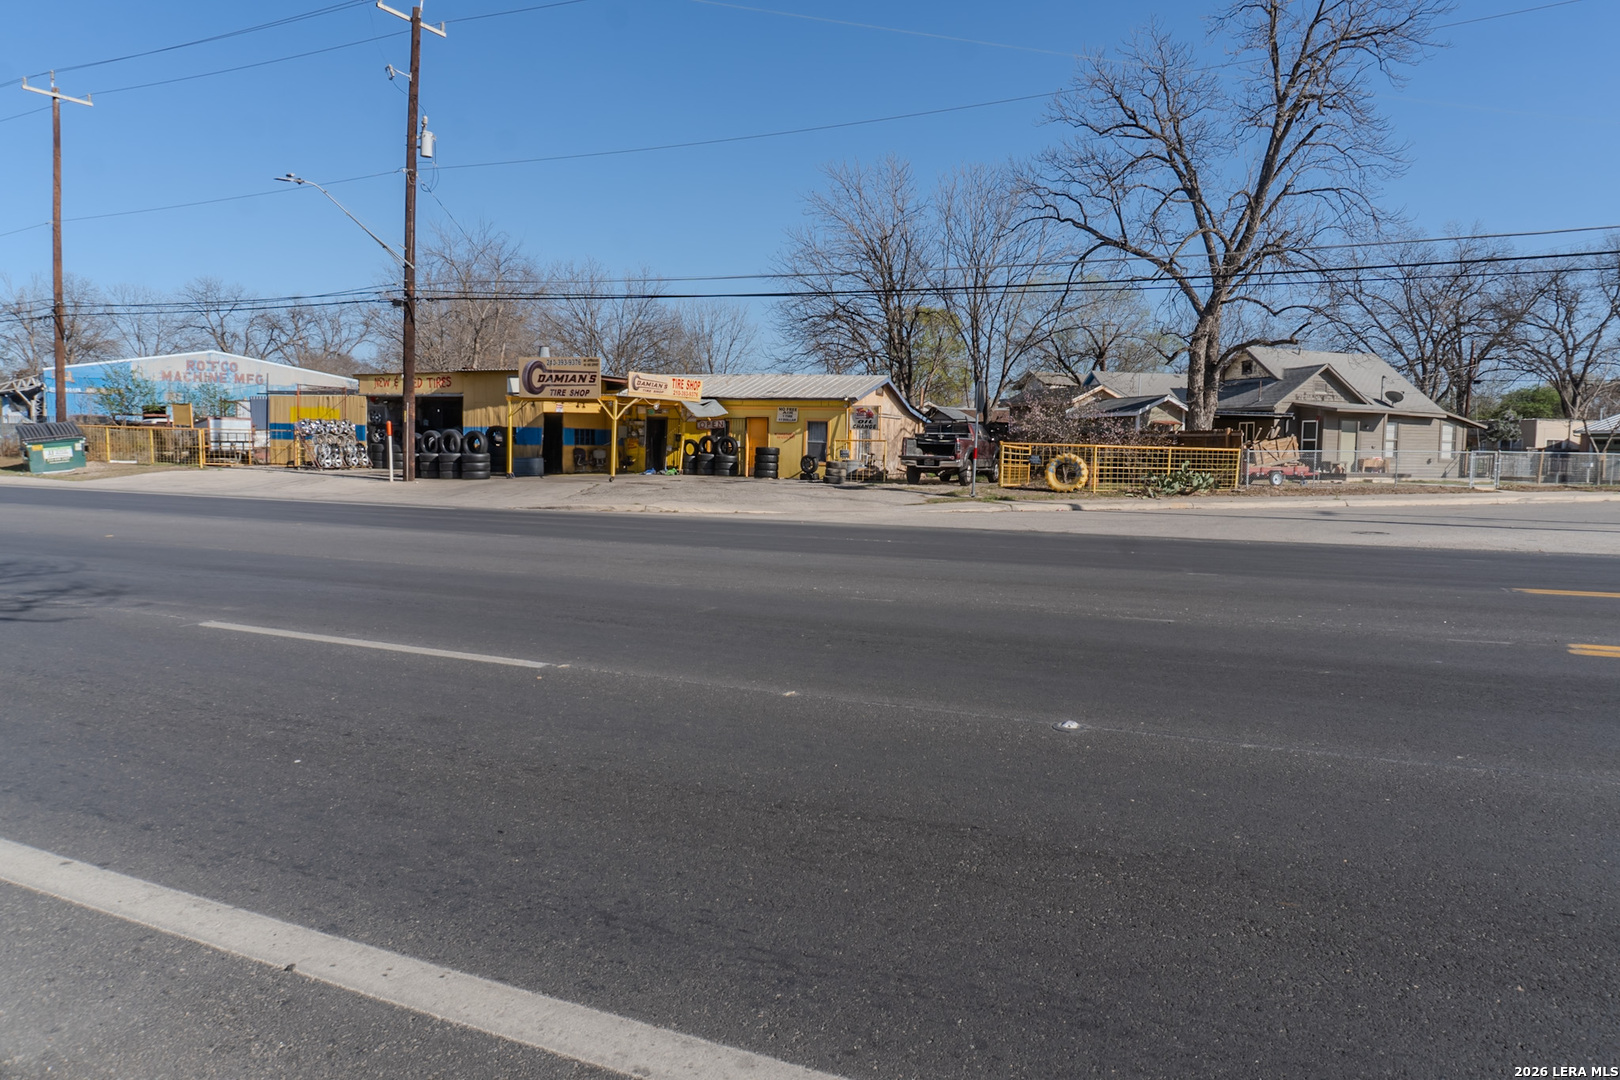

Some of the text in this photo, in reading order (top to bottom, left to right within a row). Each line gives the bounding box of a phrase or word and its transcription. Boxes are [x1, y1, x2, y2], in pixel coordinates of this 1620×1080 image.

[161, 370, 264, 385] MACHINE MFG
[374, 377, 391, 389] NEW
[393, 376, 399, 390] &
[426, 376, 452, 389] TIRES
[537, 372, 597, 383] DAMIAN'S
[636, 380, 668, 389] DAMIANS
[672, 378, 701, 391] TIRE SHOP
[569, 389, 590, 397] SHOP
[700, 420, 724, 428] OPEN
